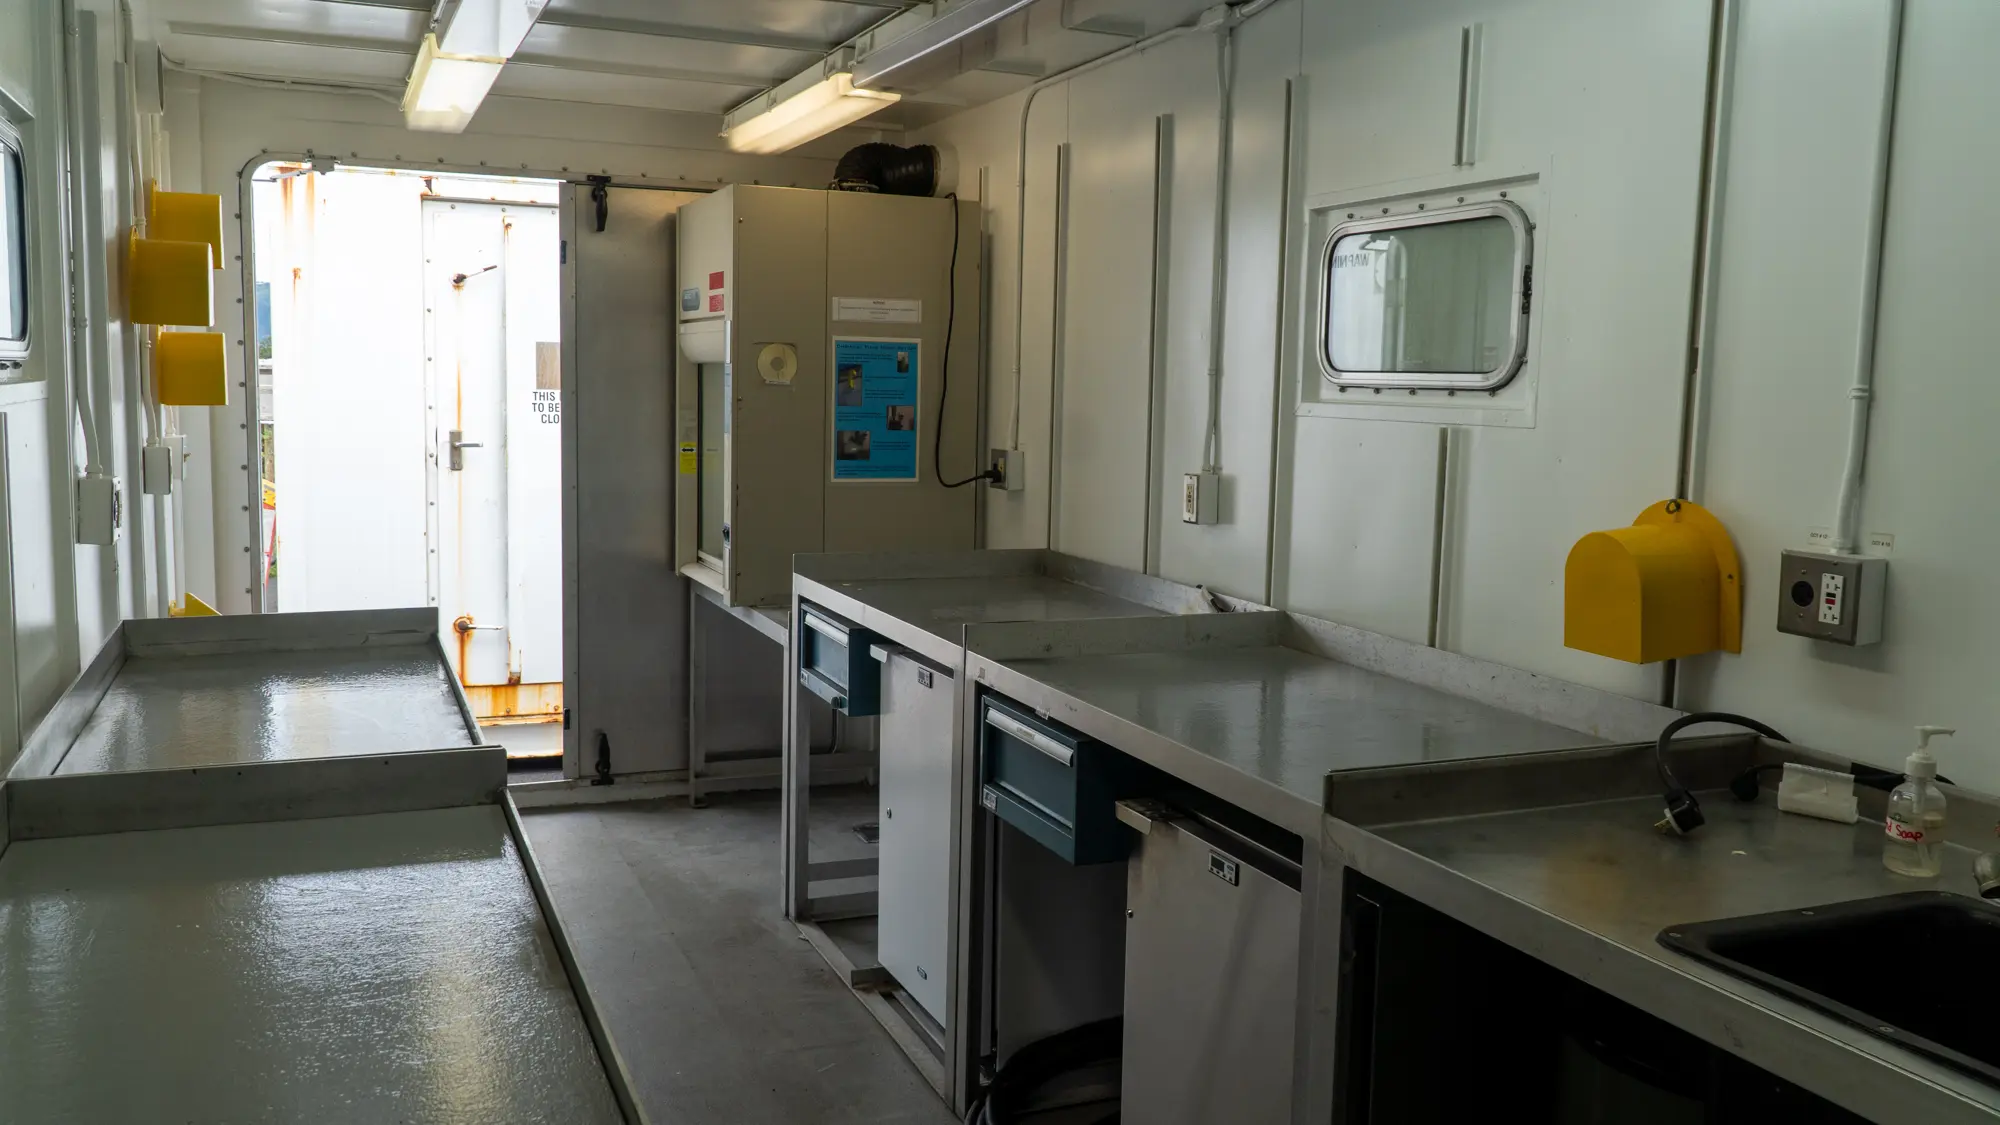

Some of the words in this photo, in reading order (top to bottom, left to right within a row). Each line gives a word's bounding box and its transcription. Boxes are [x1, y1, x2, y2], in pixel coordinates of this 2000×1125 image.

[532, 391, 556, 401] THIS
[531, 402, 545, 413] TO
[548, 402, 560, 413] BE
[541, 413, 560, 424] CLO
